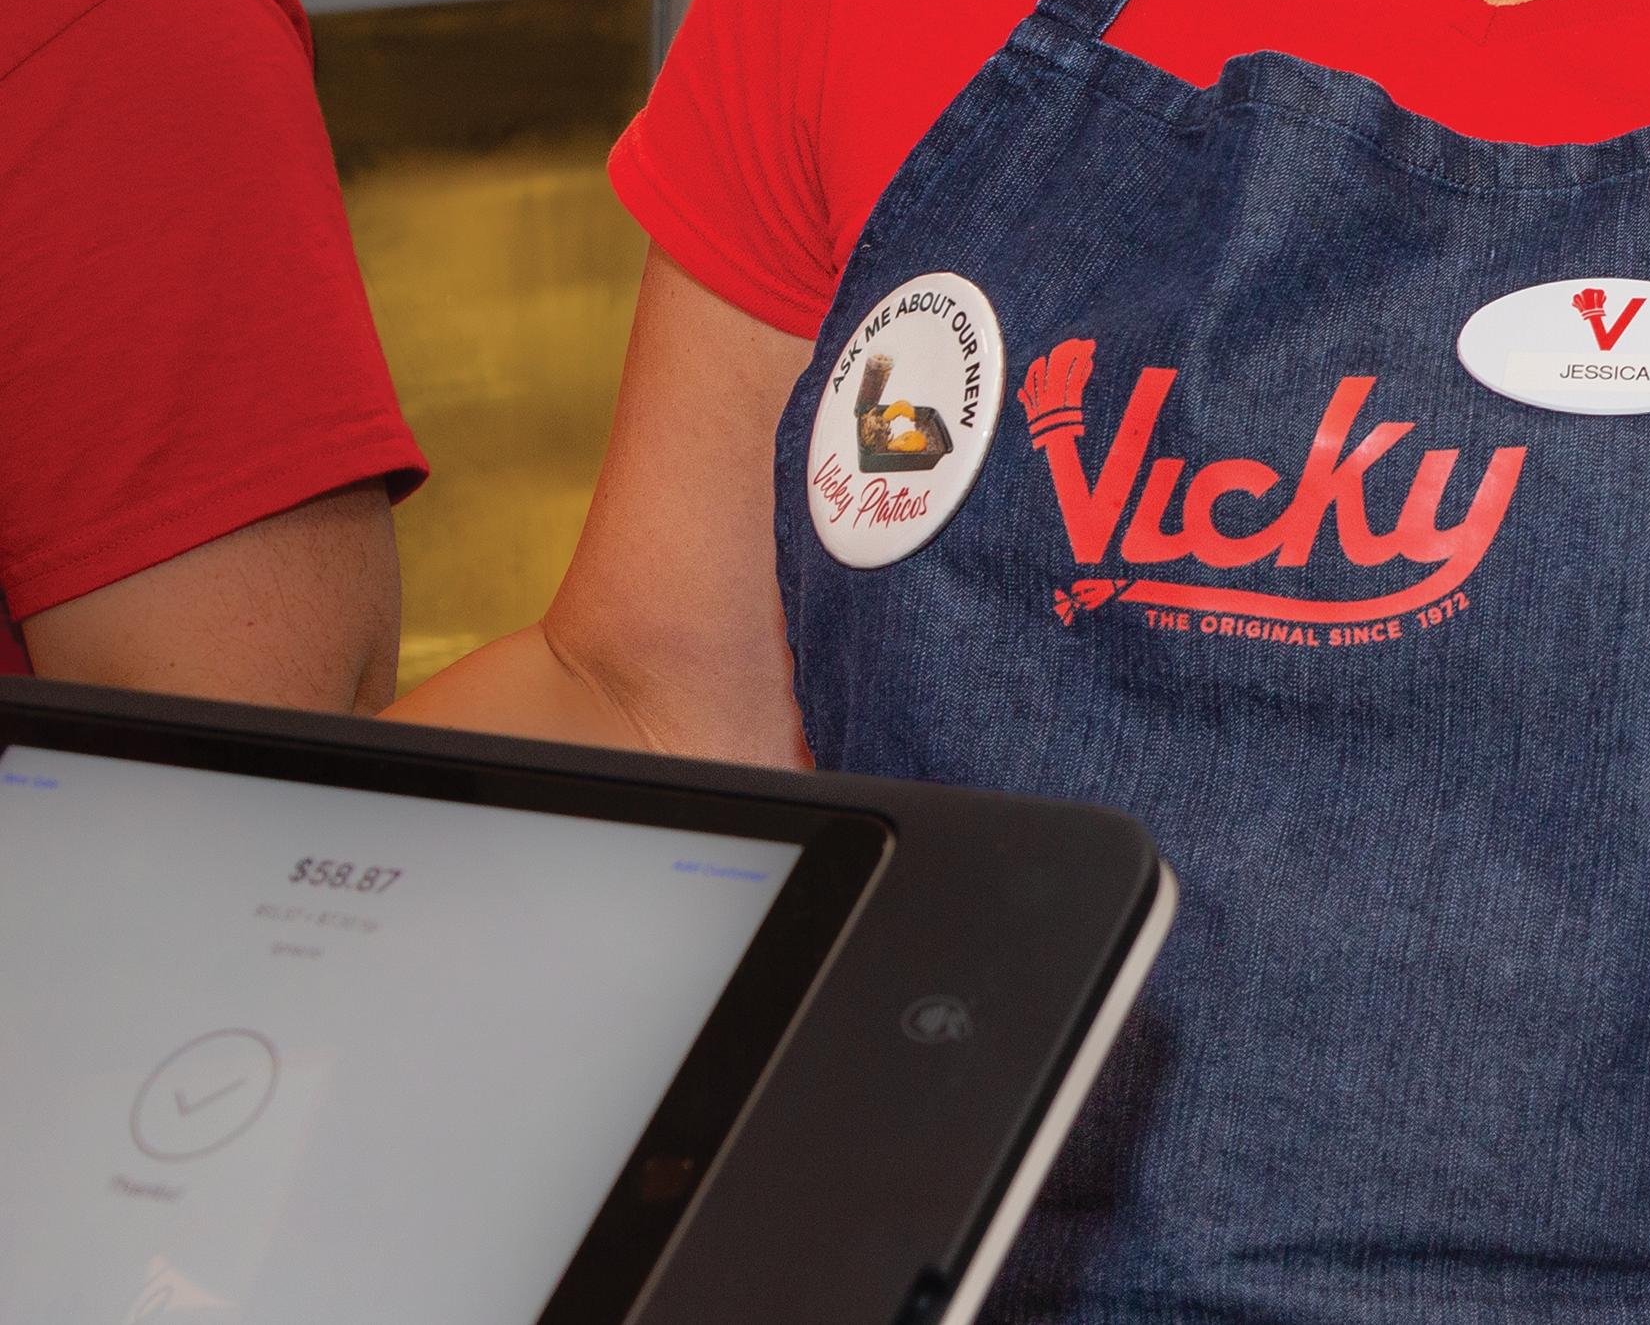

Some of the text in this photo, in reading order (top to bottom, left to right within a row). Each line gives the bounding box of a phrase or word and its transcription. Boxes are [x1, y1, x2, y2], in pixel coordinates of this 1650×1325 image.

[832, 292, 981, 428] ASK ME ABOUT OUR NEW
[1559, 364, 1650, 381] JESSICA
[812, 453, 854, 523] Vicky
[1040, 367, 1527, 623] Vicky
[1145, 591, 1470, 646] THE ORIGINAL SINCE 1972
[289, 856, 402, 893] $58.87
